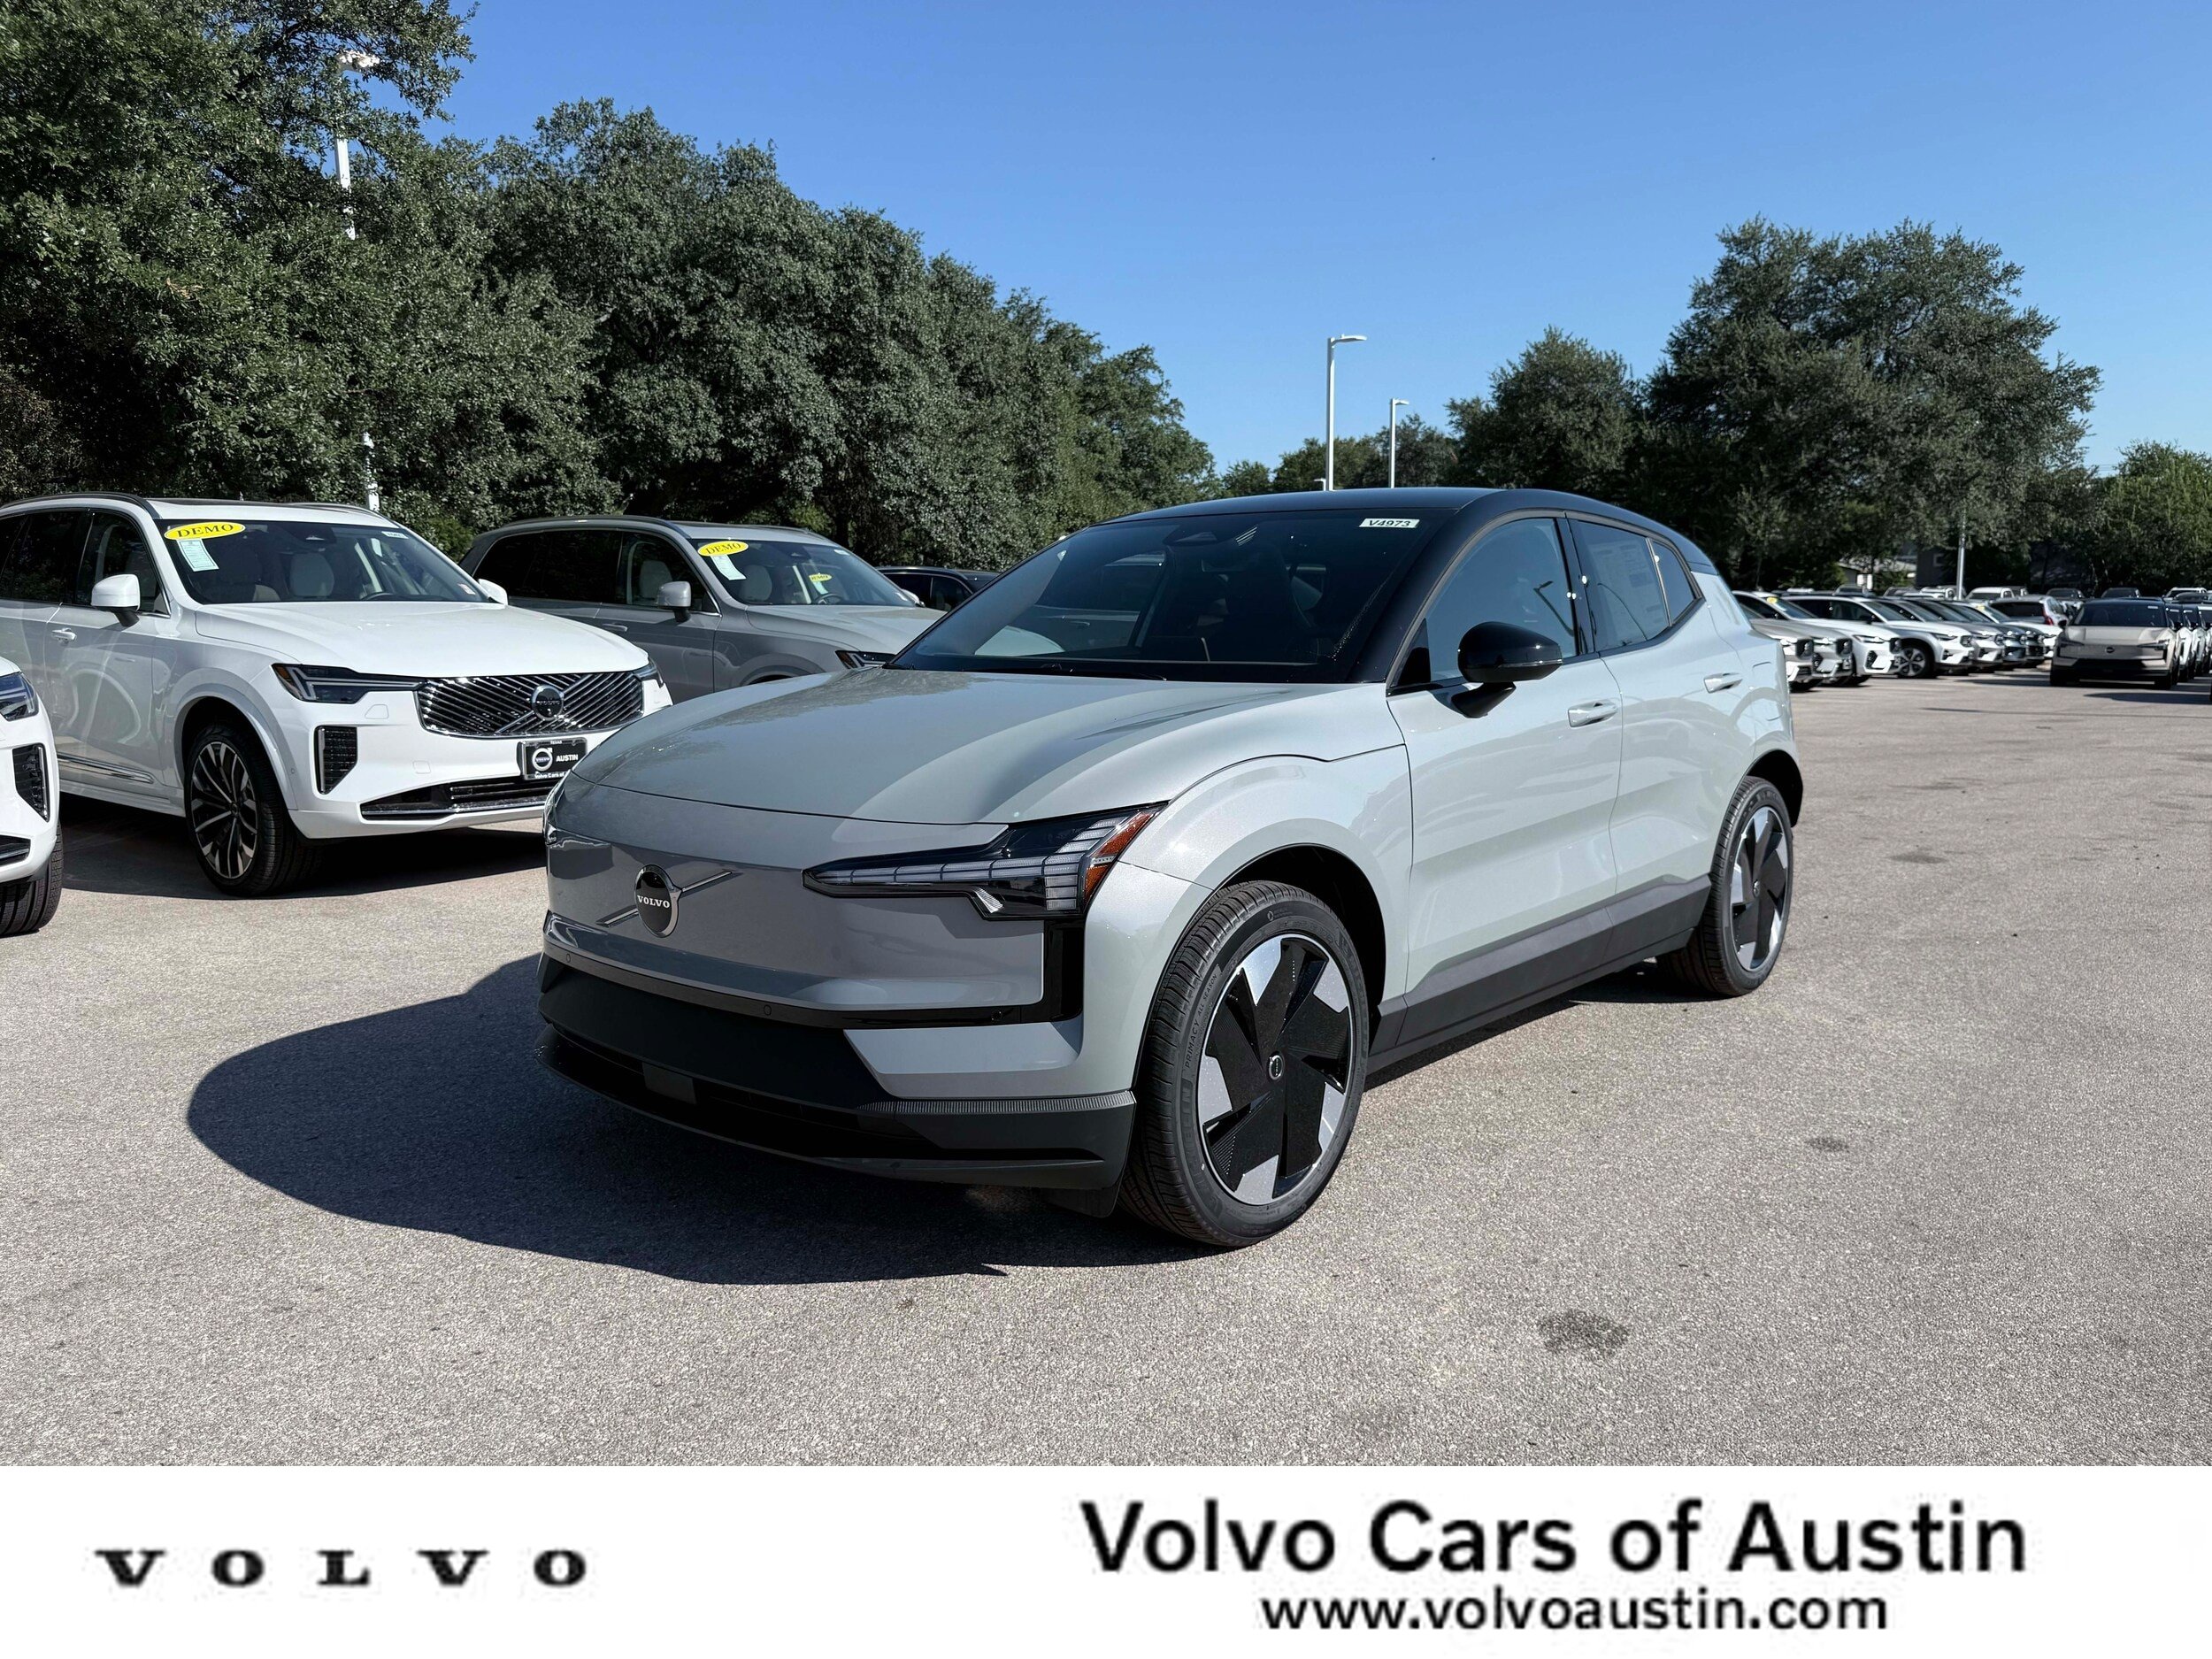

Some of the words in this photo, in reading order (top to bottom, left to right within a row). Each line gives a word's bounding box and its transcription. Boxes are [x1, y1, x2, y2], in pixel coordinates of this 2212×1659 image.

[178, 524, 234, 537] DEMO
[705, 542, 741, 554] DEMO
[637, 895, 671, 909] VOLVO
[1186, 1019, 1200, 1068] PRIMACY
[1203, 973, 1217, 1000] SEASON
